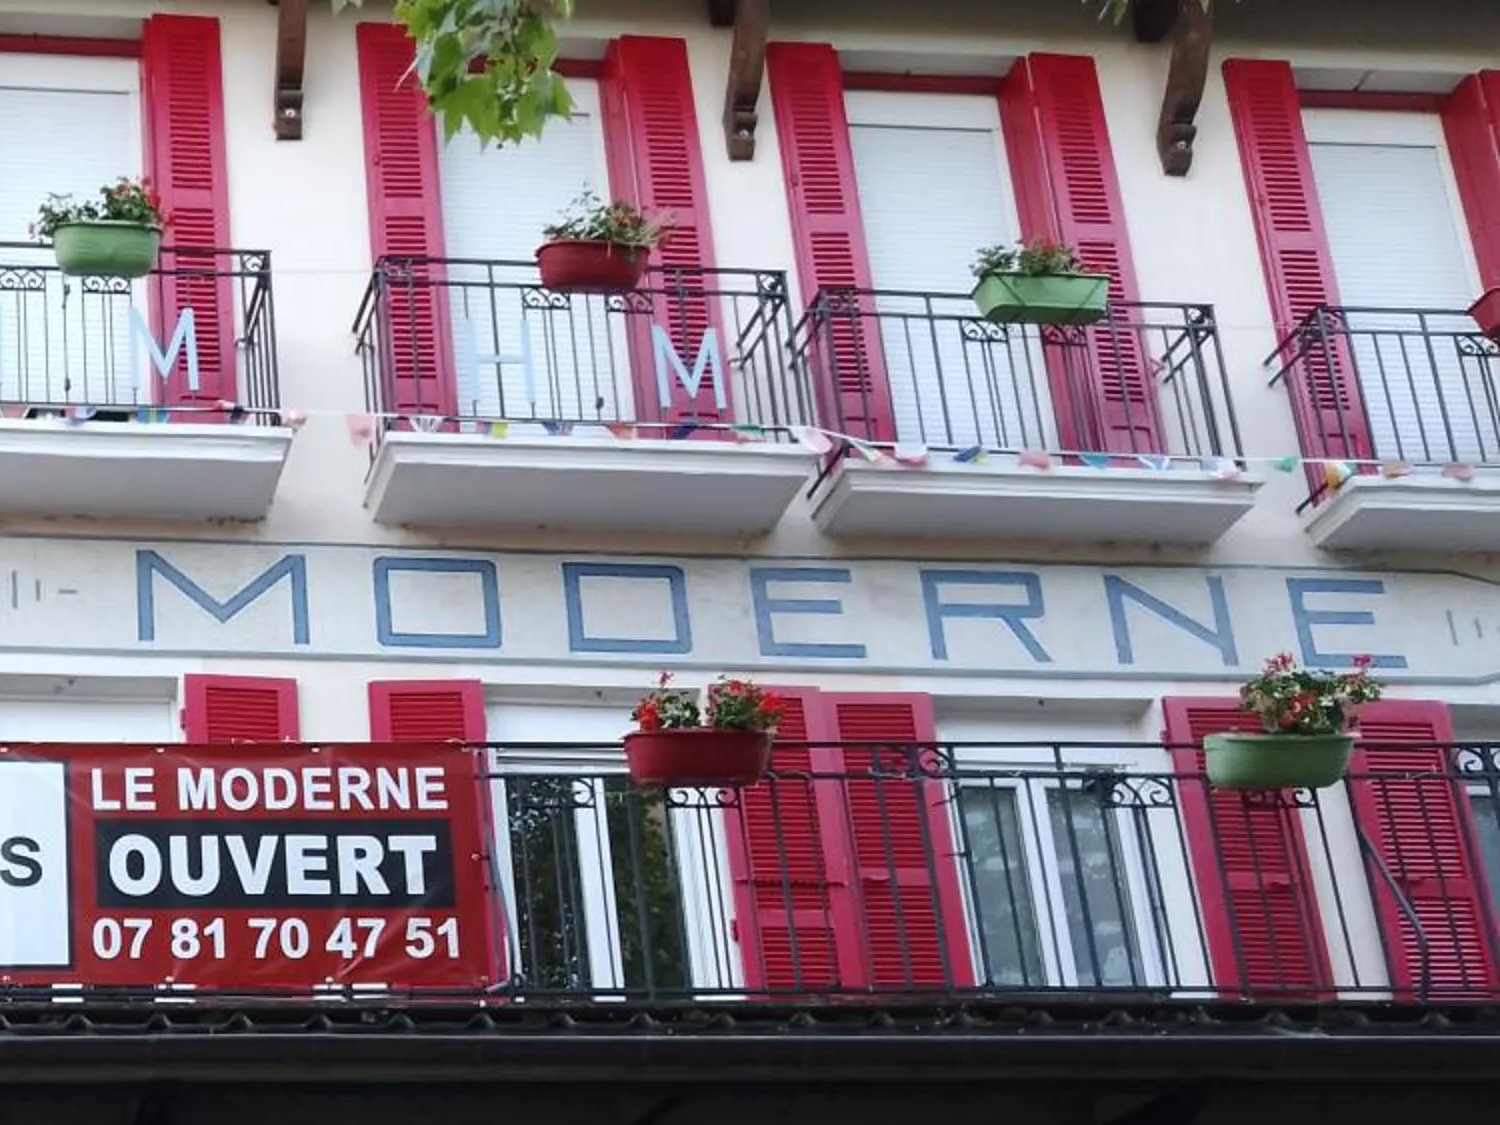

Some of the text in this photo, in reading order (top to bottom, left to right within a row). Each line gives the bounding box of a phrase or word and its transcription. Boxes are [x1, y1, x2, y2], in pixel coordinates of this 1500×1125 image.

[135, 546, 1408, 670] MODERNE
[91, 768, 448, 811] LE MODERNE
[108, 834, 437, 896] OUVERT
[91, 918, 461, 960] 07 81 70 47 51
